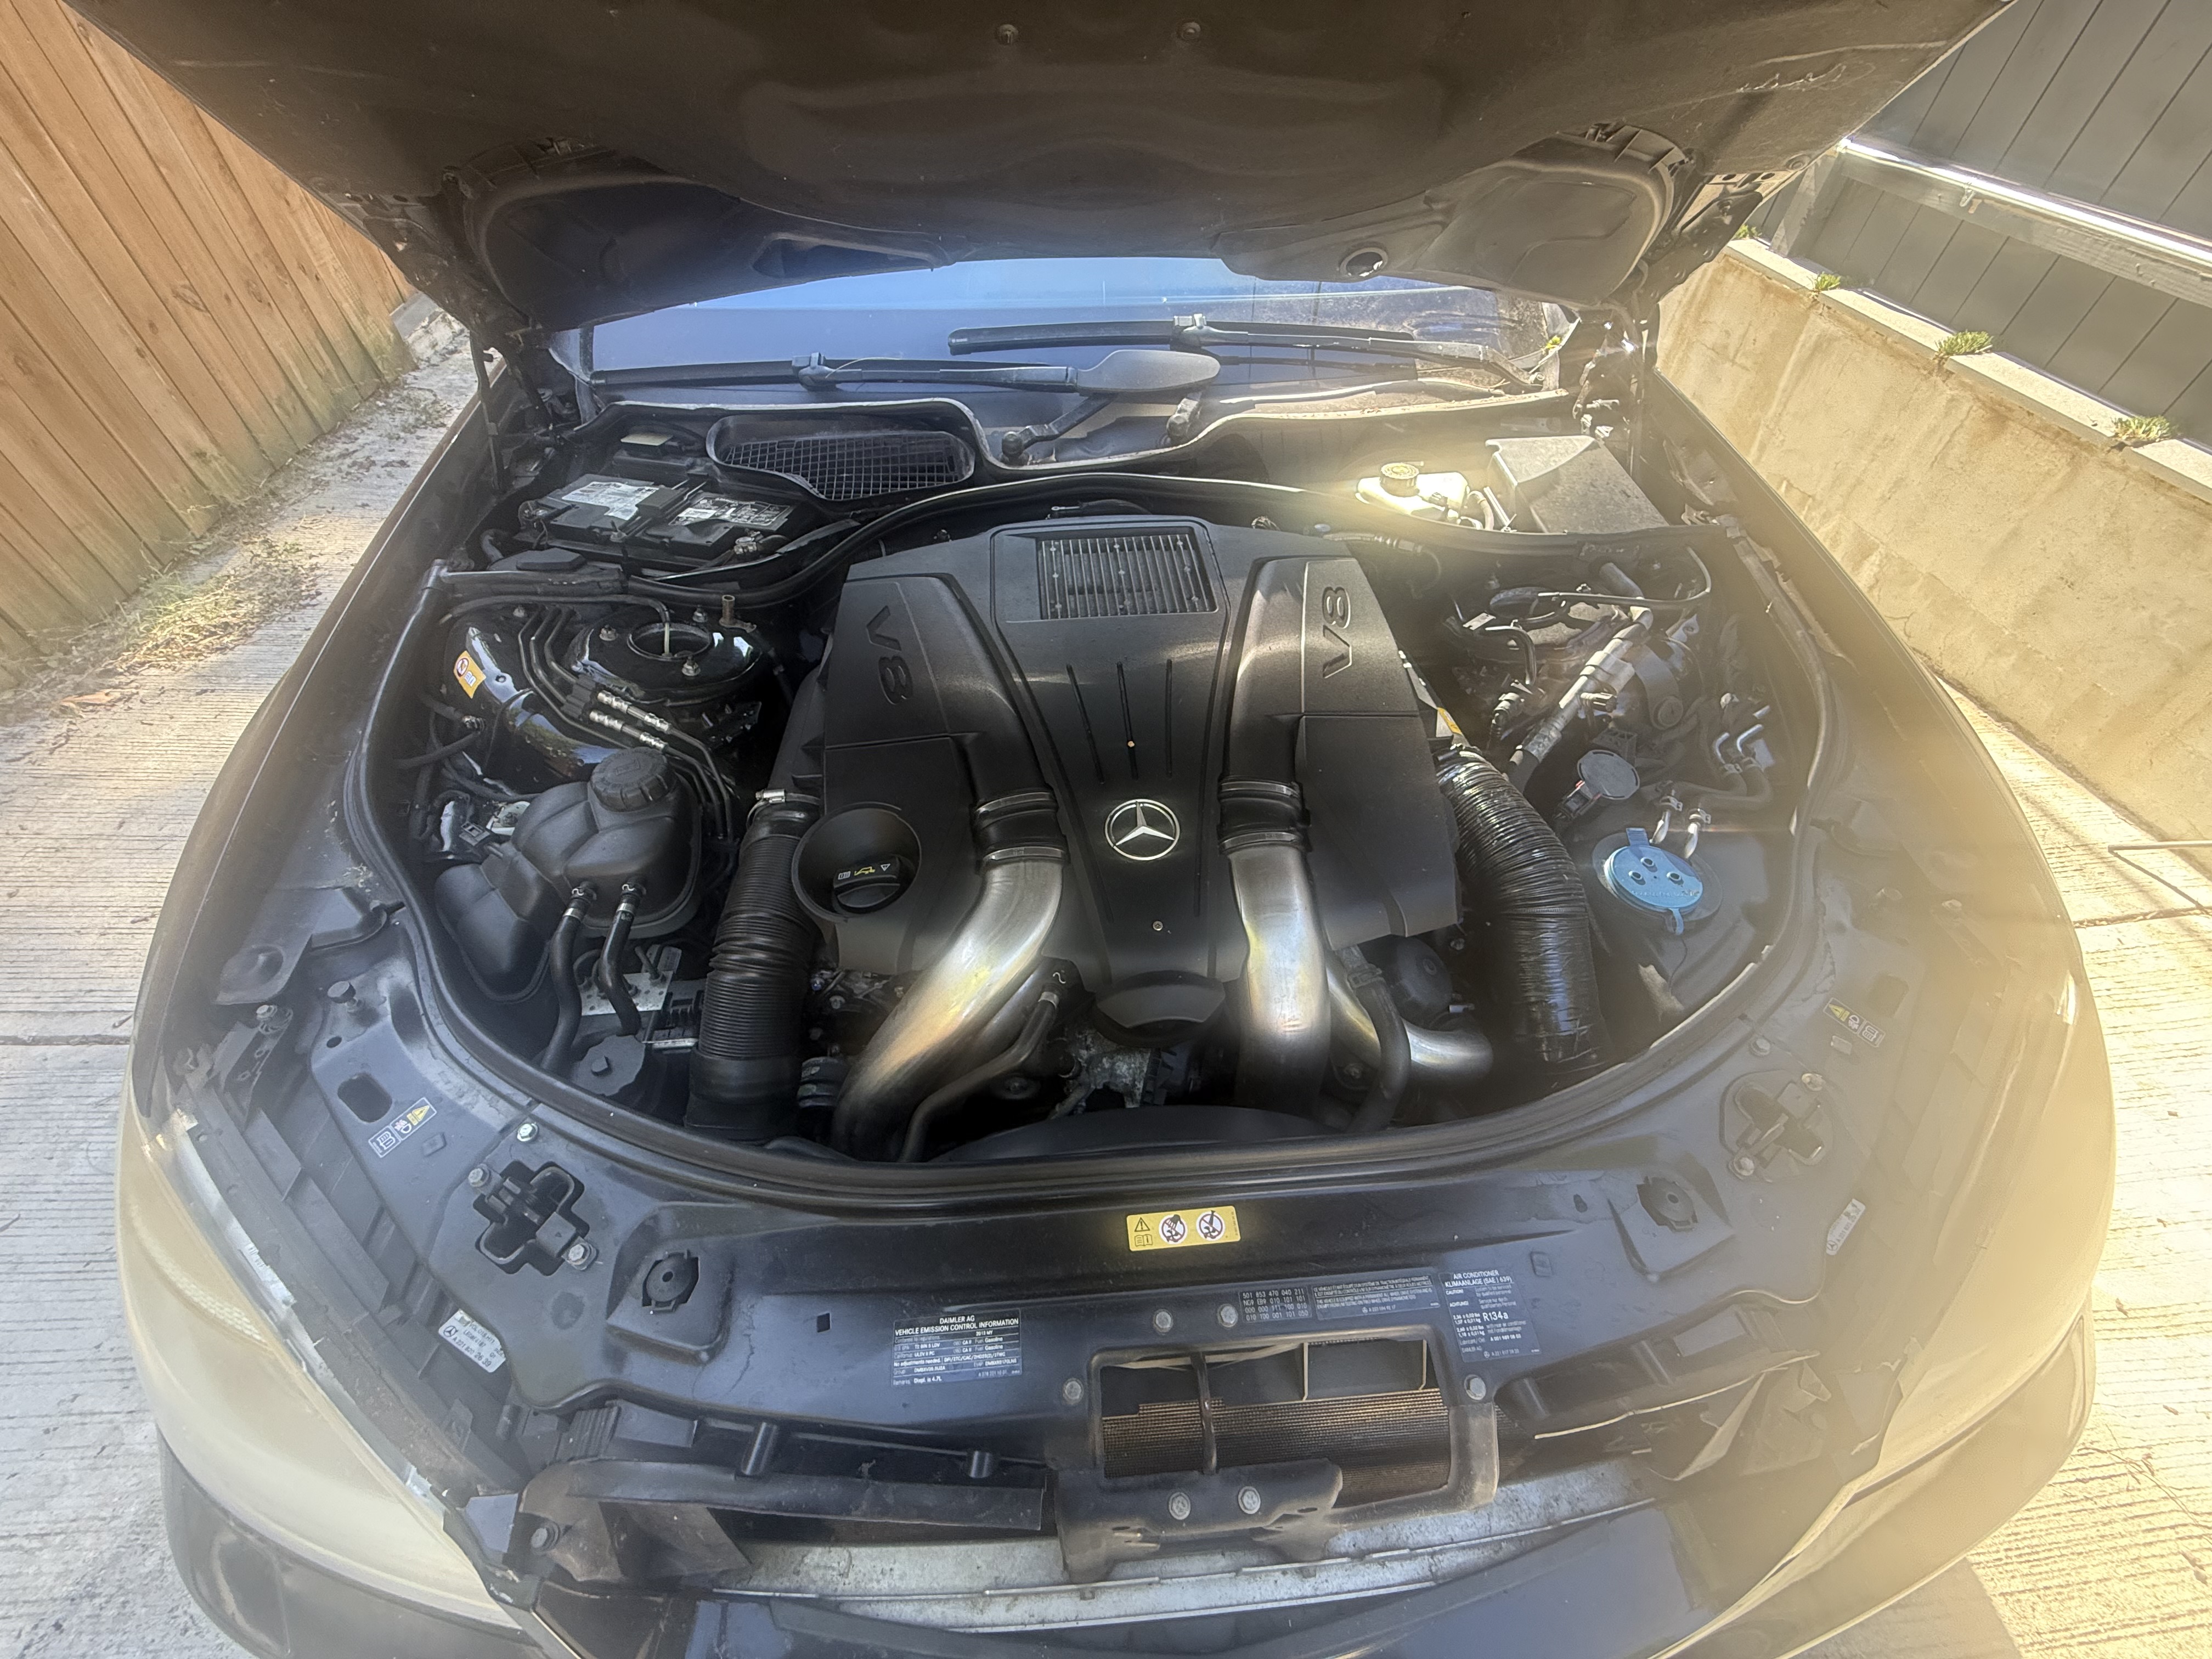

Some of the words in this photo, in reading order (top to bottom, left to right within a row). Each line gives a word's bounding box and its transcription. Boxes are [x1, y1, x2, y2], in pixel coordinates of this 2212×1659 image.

[1322, 586, 1352, 679] V8
[867, 606, 912, 705] V8
[1463, 1270, 1499, 1278] CONDITIONER
[1445, 1279, 1483, 1288] KLIMAANLAGE
[1483, 1277, 1496, 1285] (SAE
[940, 1316, 965, 1324] DAIMLER
[1482, 1311, 1509, 1322] R134a
[895, 1327, 919, 1336] VEHICLE
[920, 1325, 949, 1334] EMISSION
[950, 1322, 978, 1331] CONTROL
[979, 1318, 1019, 1328] INFORMATION
[456, 1339, 466, 1348] 221
[474, 1352, 484, 1361] 26
[482, 1357, 492, 1367] 39
